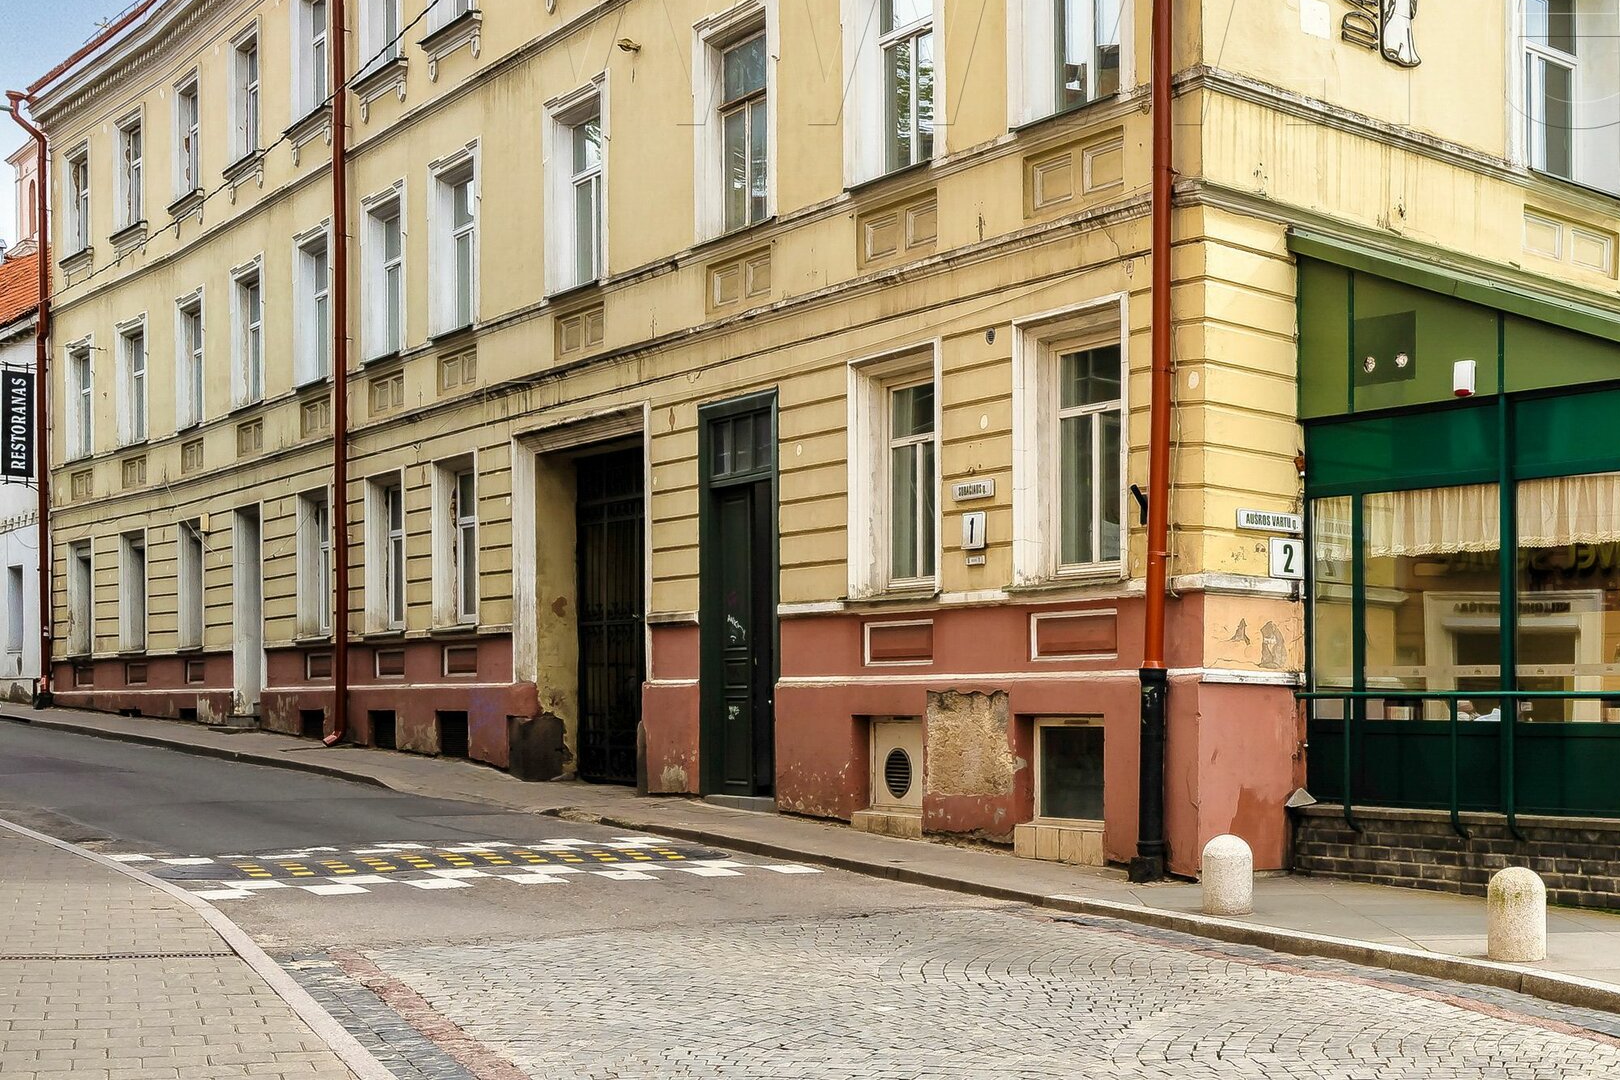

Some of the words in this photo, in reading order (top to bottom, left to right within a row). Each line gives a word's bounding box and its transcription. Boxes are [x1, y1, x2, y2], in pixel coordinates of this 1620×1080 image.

[11, 378, 26, 470] RESTORANAS
[969, 517, 974, 544] 1
[1246, 513, 1270, 526] AUŠROS
[1283, 544, 1294, 573] 2
